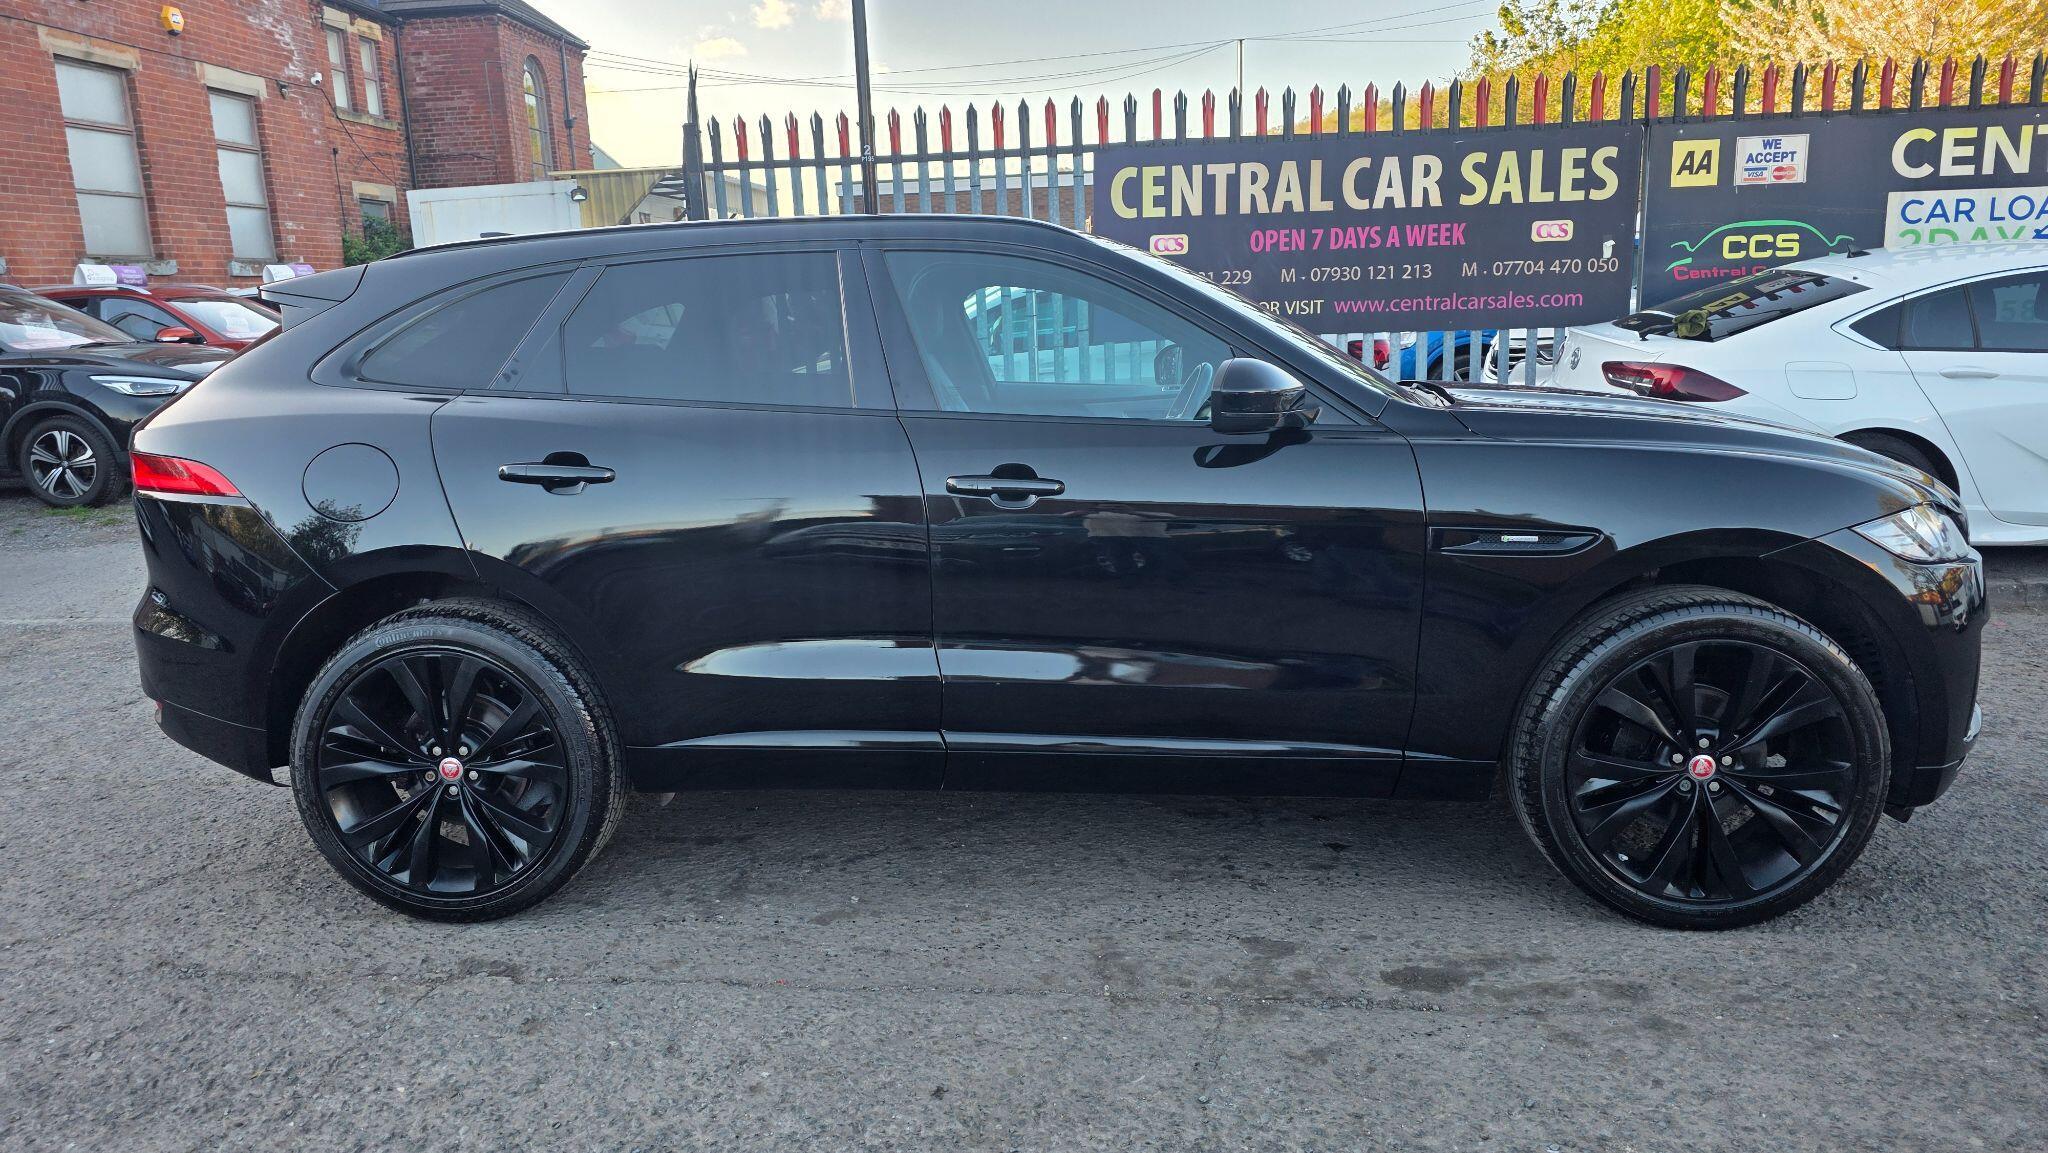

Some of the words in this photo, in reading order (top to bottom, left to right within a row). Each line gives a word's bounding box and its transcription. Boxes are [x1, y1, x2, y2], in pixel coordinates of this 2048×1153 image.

[1762, 139, 1782, 150] WE
[1891, 124, 2048, 179] CEN
[1676, 150, 1712, 175] AA
[1746, 151, 1797, 164] ACCEPT
[1110, 159, 1333, 219] CENTRAL
[1342, 154, 1442, 210] CAR
[1459, 146, 1618, 206] SALES
[1901, 198, 1975, 224] CAR
[1250, 229, 1305, 253] OPEN
[1312, 228, 1323, 250] 7
[1330, 225, 1381, 249] DAYS
[1386, 225, 1400, 248] A
[1406, 222, 1467, 247] WEEK
[1723, 233, 1799, 260] CCS
[1222, 270, 1252, 285] 229
[1281, 268, 1296, 283] M
[1310, 266, 1361, 283] 07930
[1368, 264, 1394, 280] 121
[1402, 263, 1432, 279] 213
[1462, 262, 1477, 277] M
[1493, 260, 1545, 276] 07704
[1550, 258, 1582, 274] 470
[1587, 257, 1619, 273] 050
[1673, 265, 1746, 281] Central
[1285, 299, 1325, 315] VISIT
[1334, 290, 1583, 314] www.centralcarsales.com
